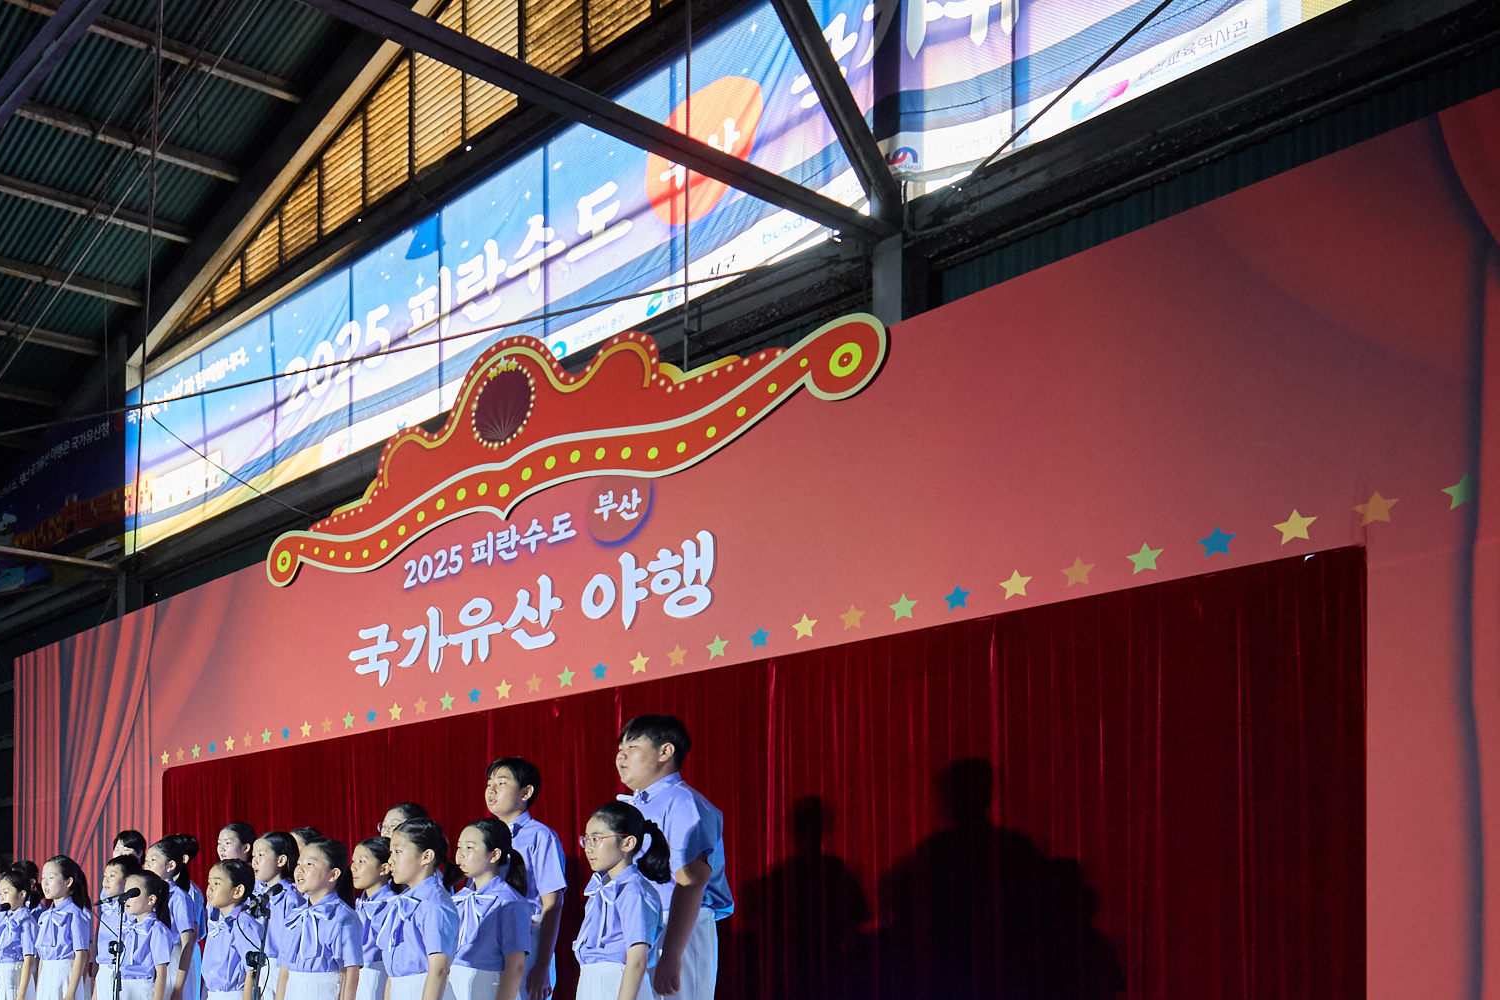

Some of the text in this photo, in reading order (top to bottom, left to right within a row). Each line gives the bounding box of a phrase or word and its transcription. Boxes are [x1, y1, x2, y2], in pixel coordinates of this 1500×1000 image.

[283, 181, 634, 417] 2025 피란수도
[71, 422, 110, 450] 국가유산청
[593, 487, 643, 522] 부산
[403, 512, 577, 589] 2025 피란수도
[348, 530, 715, 688] 국가유산 야행
